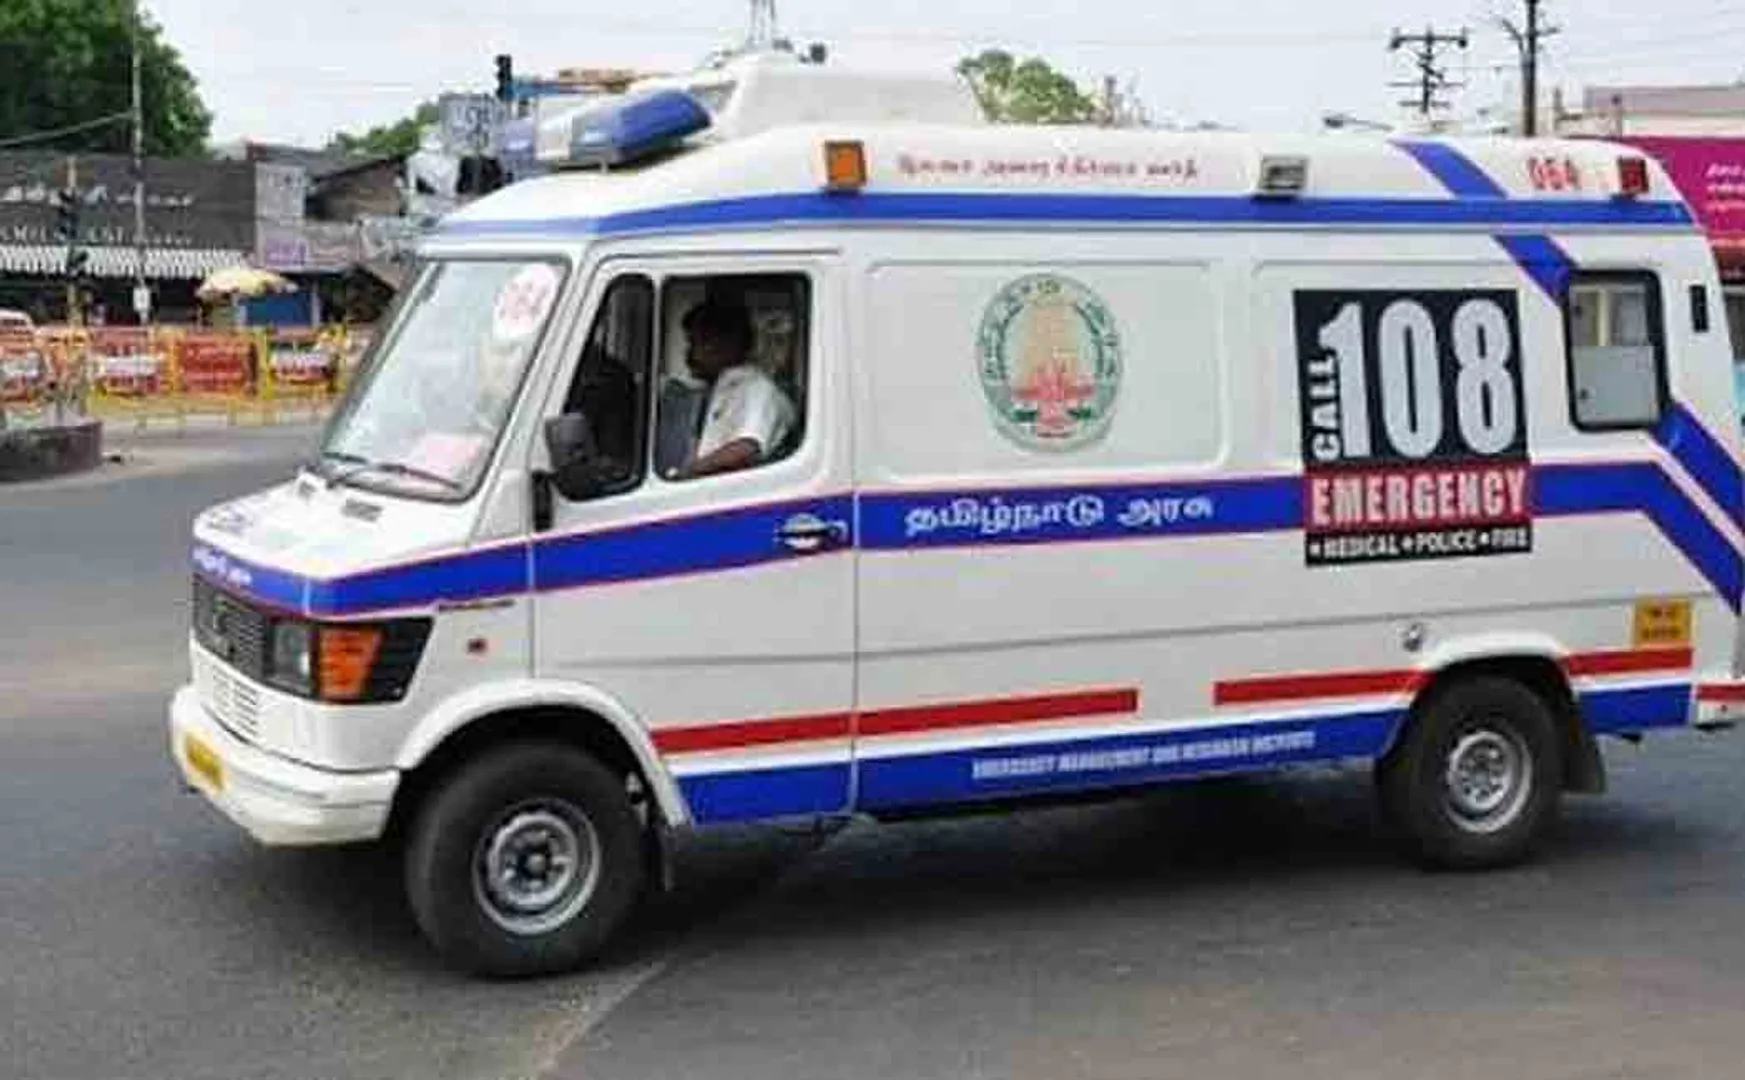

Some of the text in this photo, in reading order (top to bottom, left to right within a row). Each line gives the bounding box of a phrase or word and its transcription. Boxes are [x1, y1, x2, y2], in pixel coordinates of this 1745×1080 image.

[1319, 299, 1517, 458] 108
[1308, 355, 1341, 461] CALL
[904, 494, 1104, 537] தமிழ்நாடு
[1312, 469, 1525, 526] EMERGENCY
[1324, 534, 1399, 558] MEDICAL
[1416, 529, 1477, 552] POLICE
